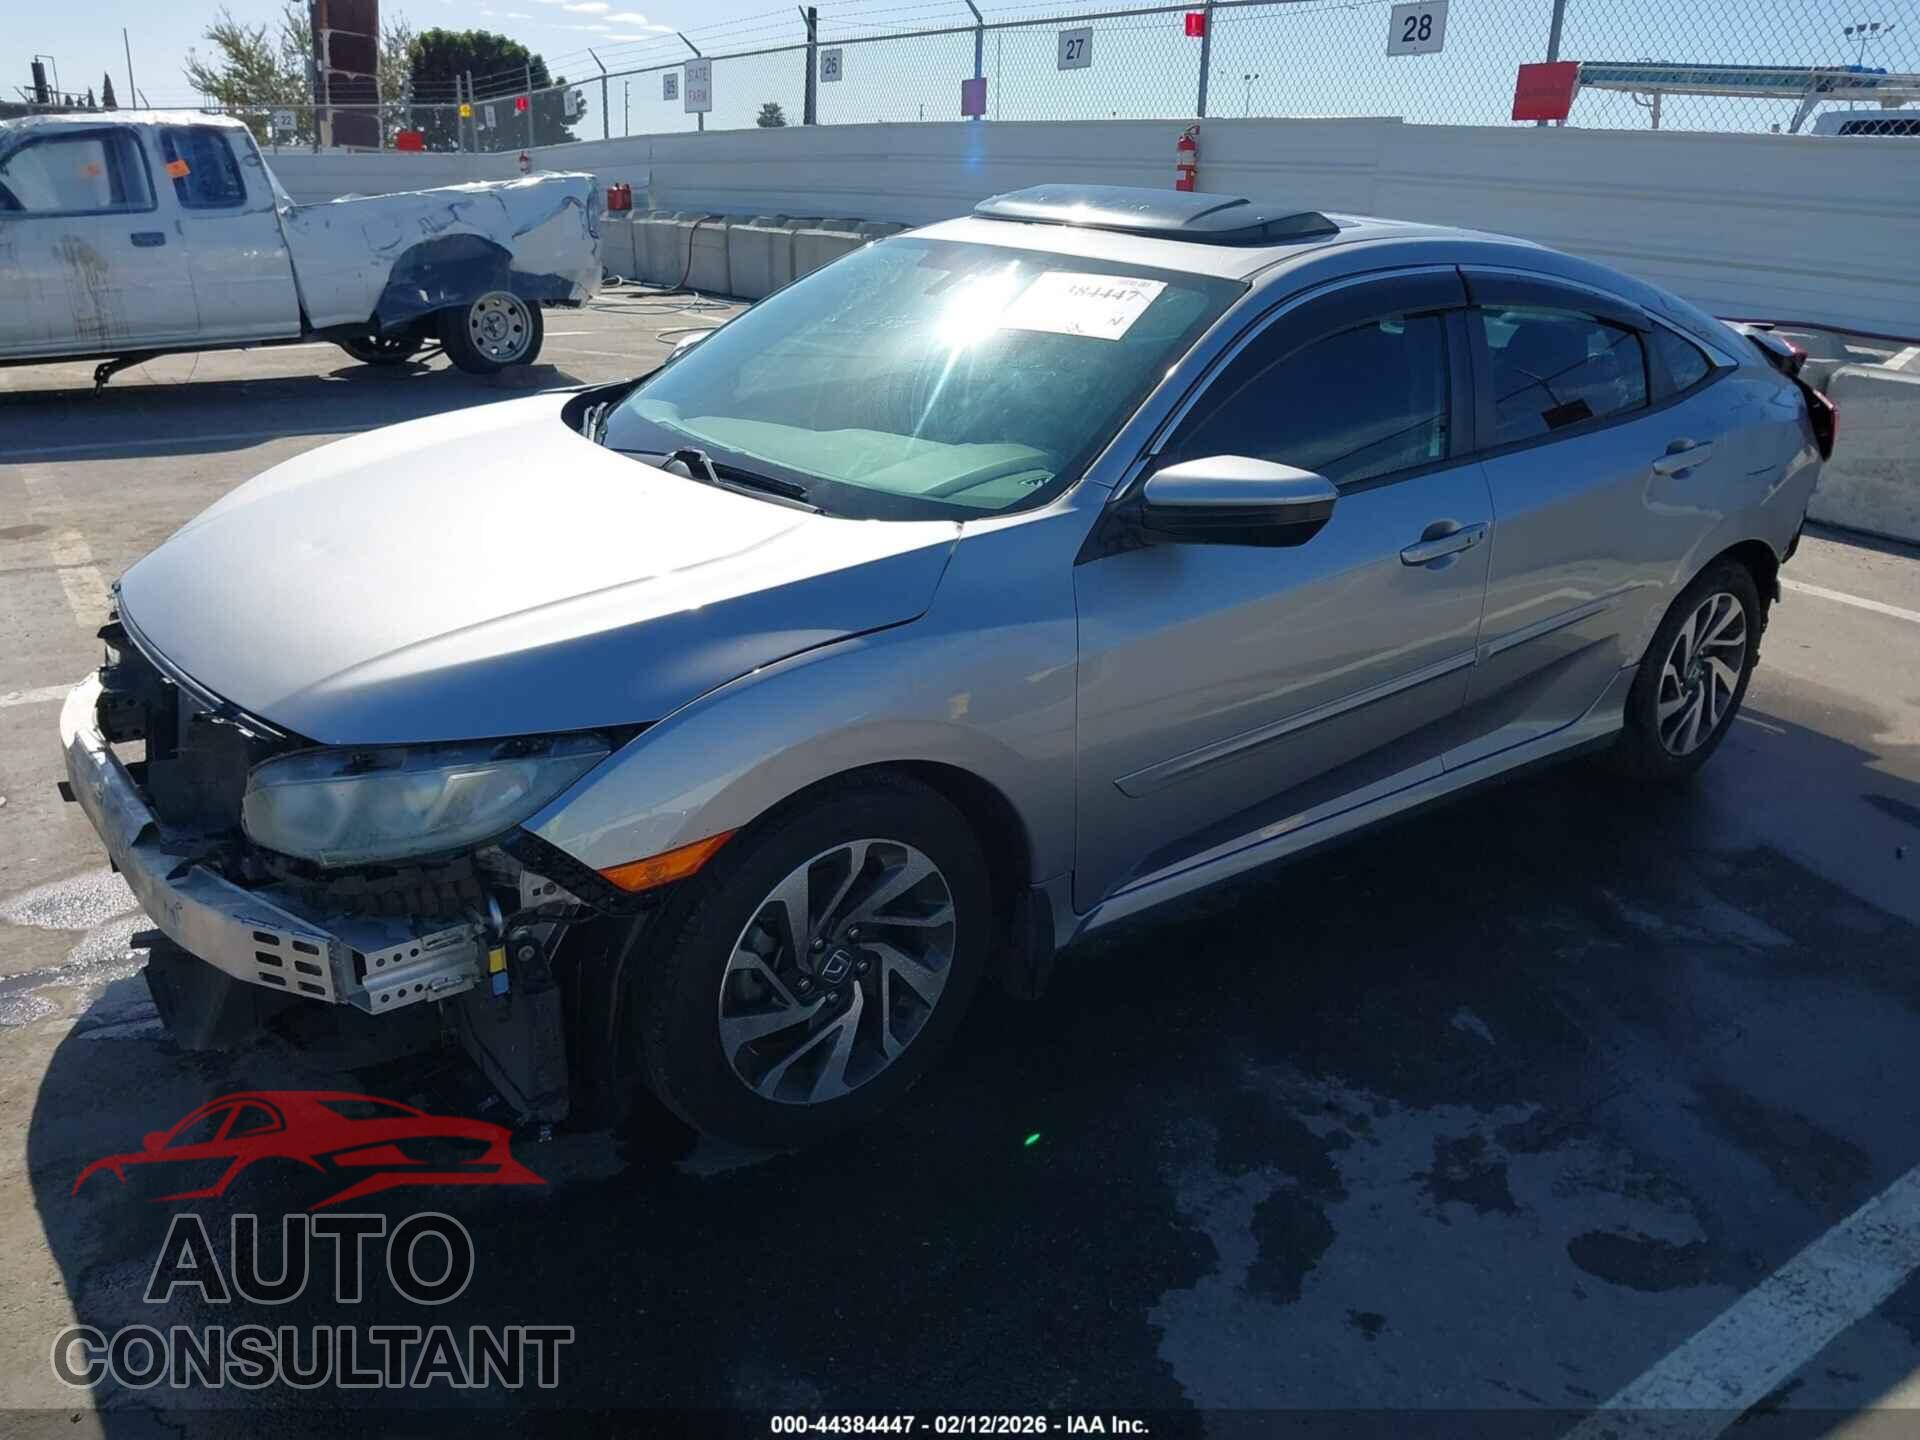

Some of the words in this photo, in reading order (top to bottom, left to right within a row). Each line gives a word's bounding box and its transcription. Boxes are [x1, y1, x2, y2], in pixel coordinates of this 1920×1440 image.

[1402, 14, 1433, 42] 28
[1066, 38, 1085, 60] 27
[825, 57, 837, 74] 26
